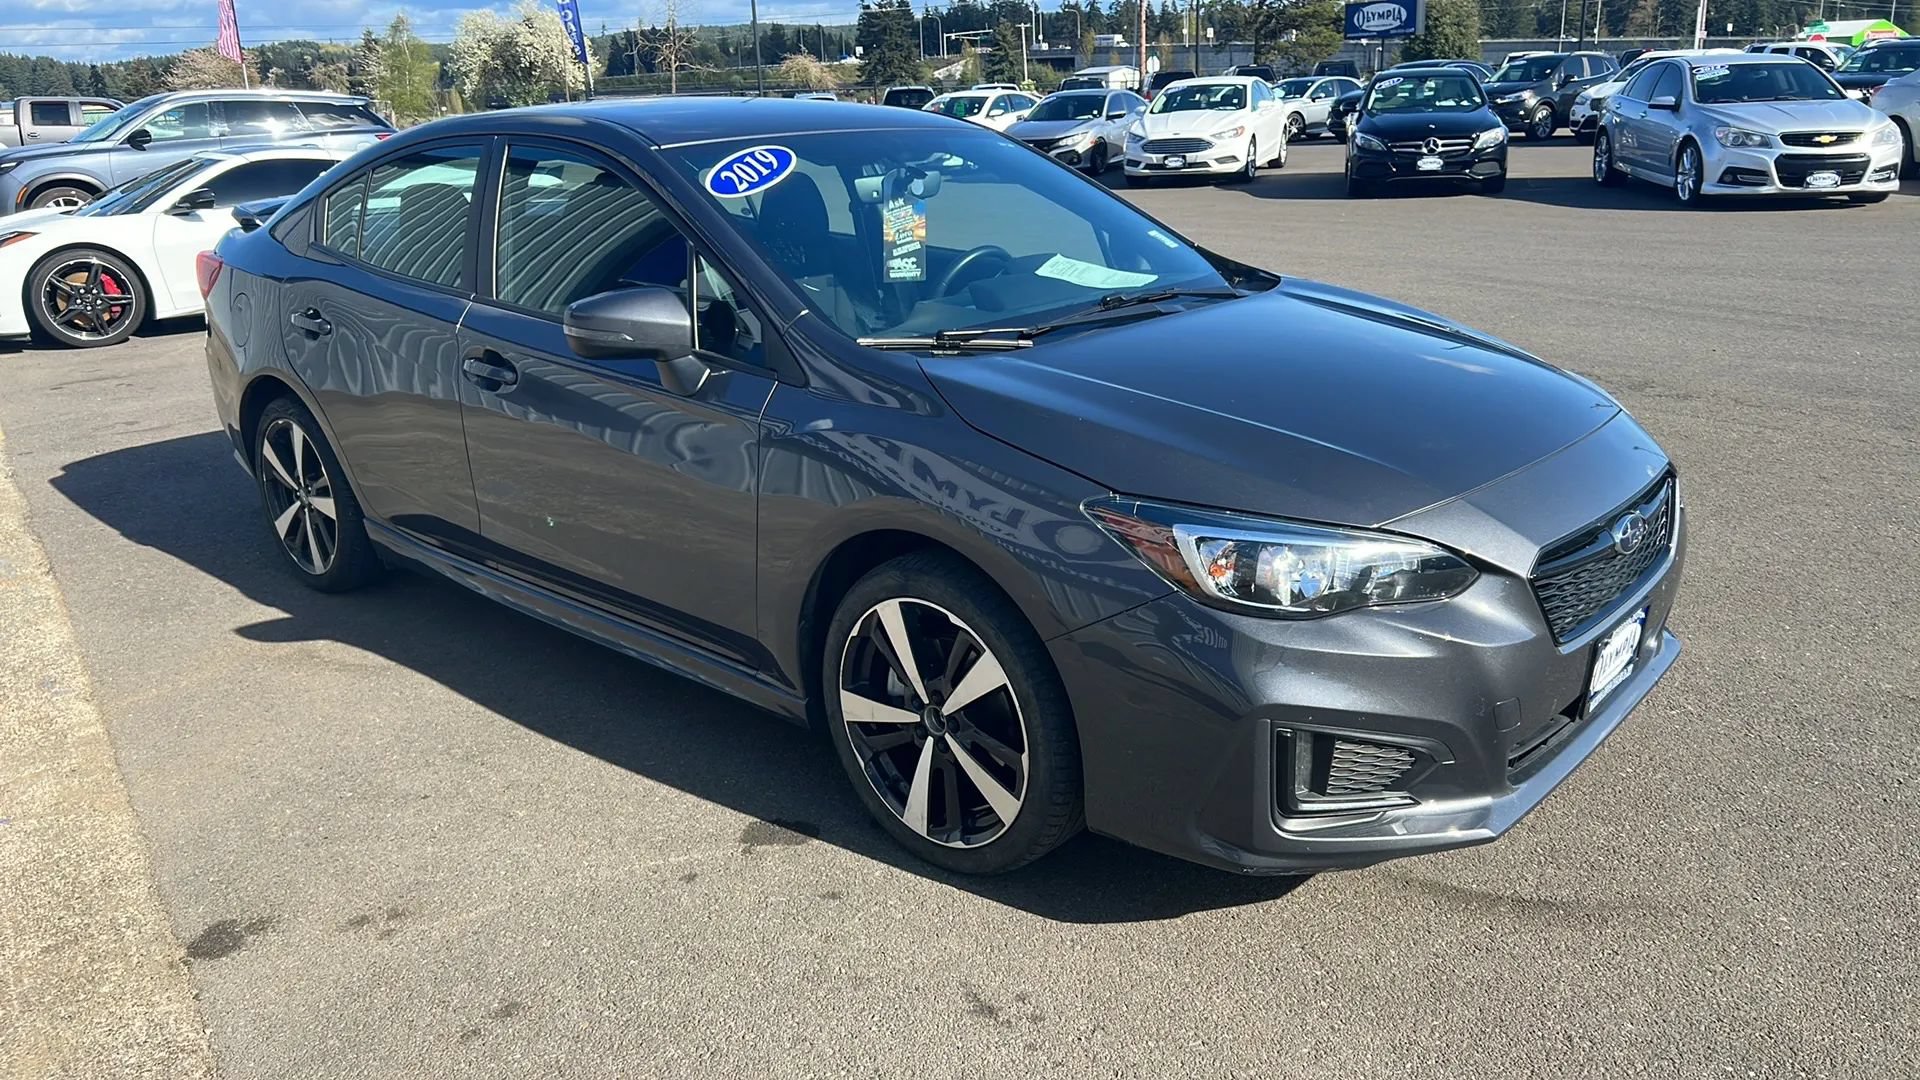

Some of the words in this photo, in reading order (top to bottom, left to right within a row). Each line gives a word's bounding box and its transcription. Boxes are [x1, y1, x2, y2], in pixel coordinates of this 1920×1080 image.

[1357, 6, 1403, 30] OLYMPIA
[721, 149, 778, 192] 2019
[888, 197, 906, 209] Ask
